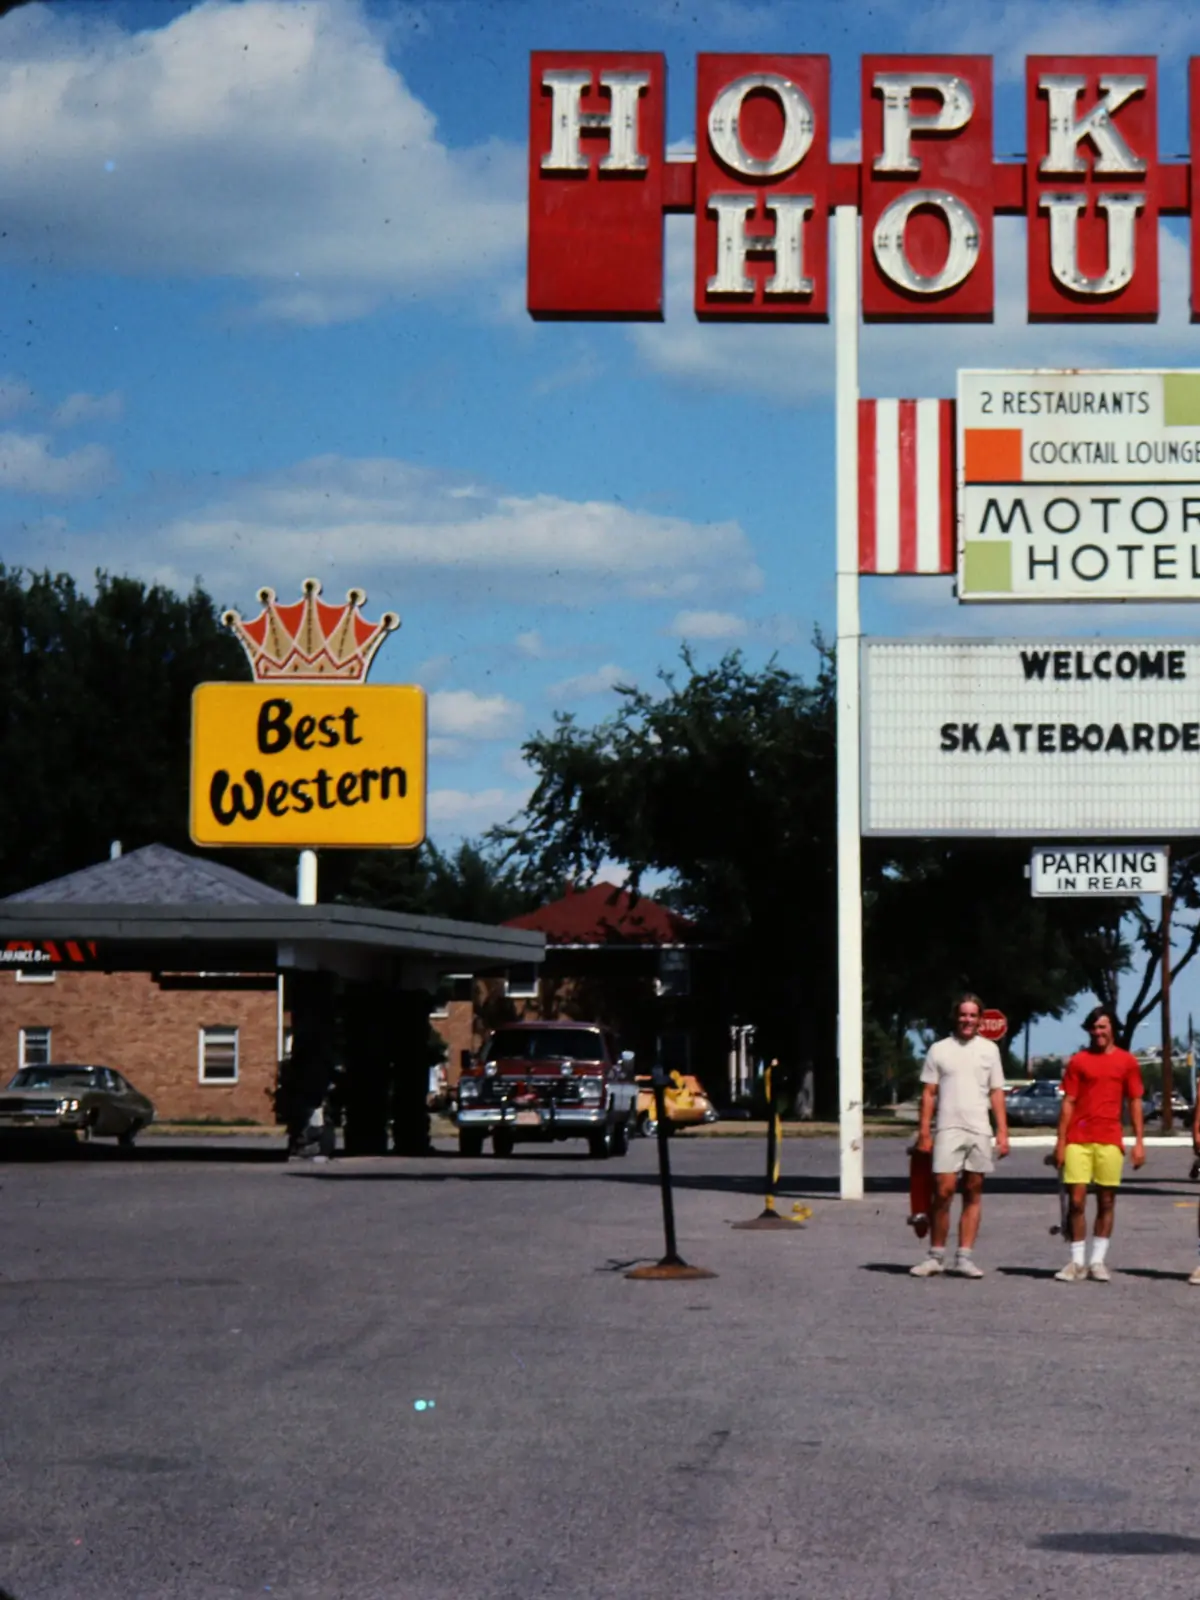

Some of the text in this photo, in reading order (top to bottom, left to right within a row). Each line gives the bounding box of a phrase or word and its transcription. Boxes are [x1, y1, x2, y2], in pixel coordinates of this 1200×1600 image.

[980, 391, 1150, 414] 2 RESTAURANTS
[1029, 441, 1119, 464] COCKTAIL
[1020, 650, 1187, 681] WELCOME
[257, 698, 363, 755] Best
[210, 766, 407, 826] Western
[1042, 853, 1157, 875] PARKING
[1057, 877, 1142, 890] IN REAR
